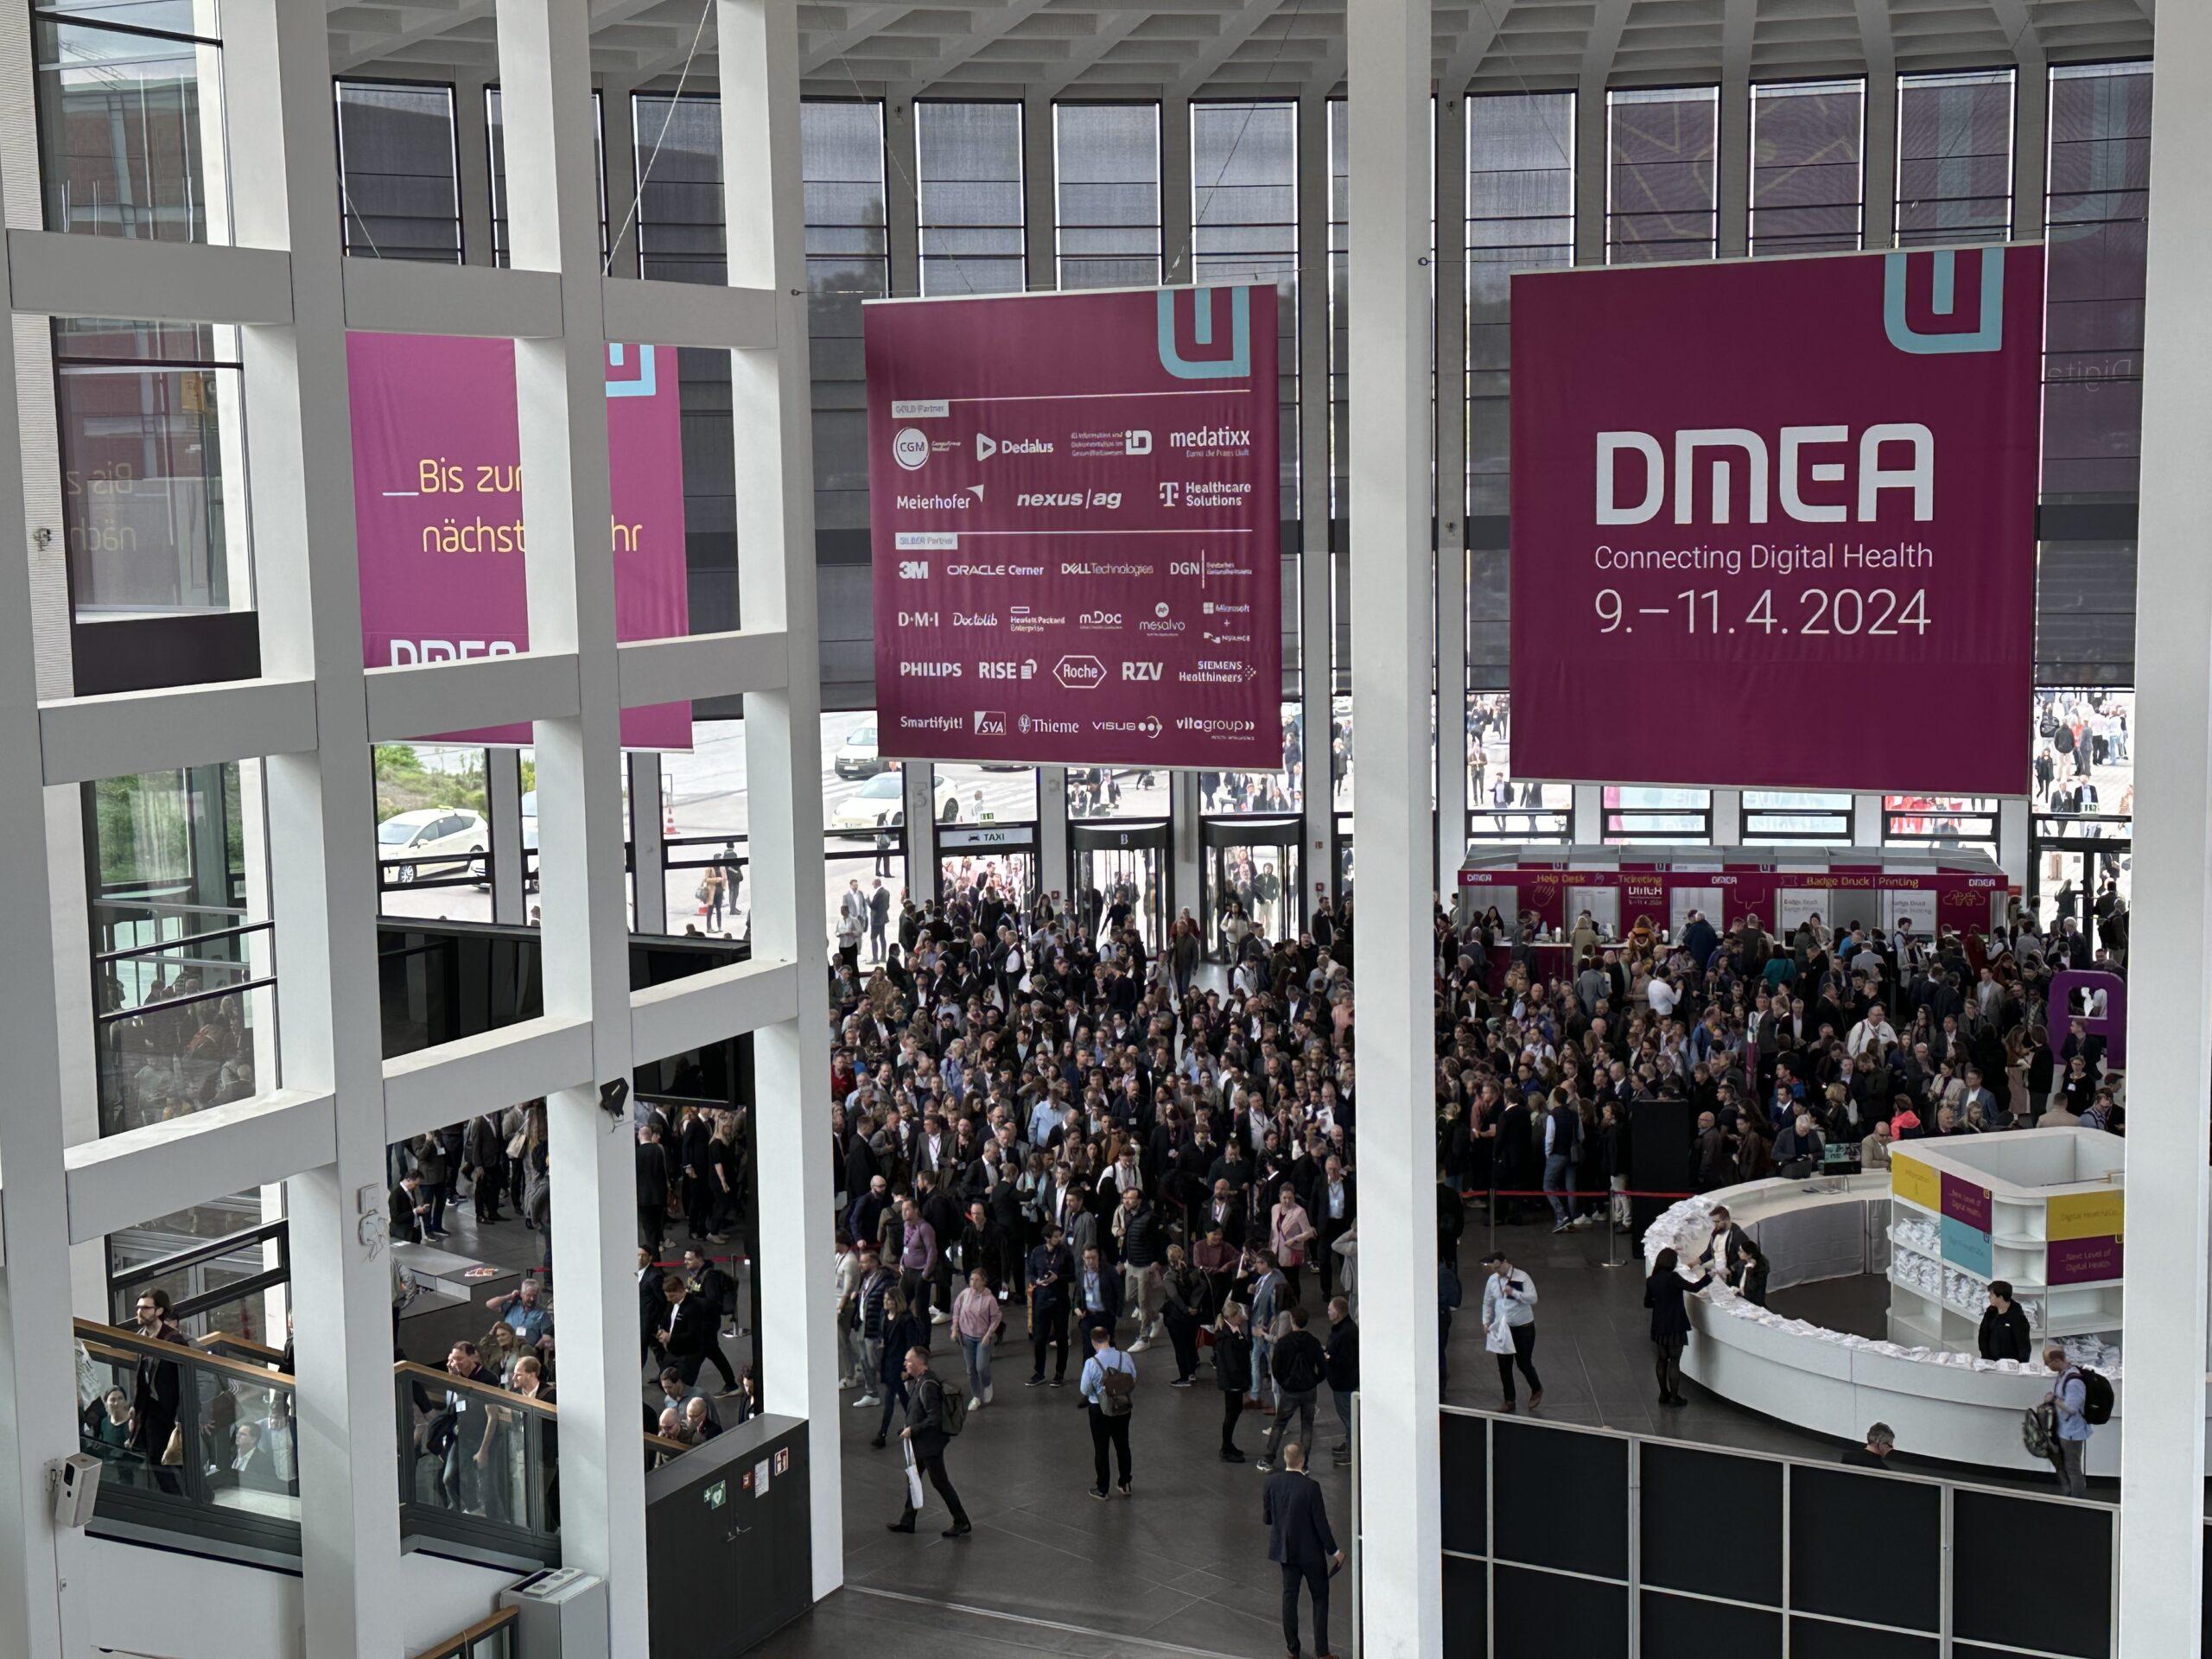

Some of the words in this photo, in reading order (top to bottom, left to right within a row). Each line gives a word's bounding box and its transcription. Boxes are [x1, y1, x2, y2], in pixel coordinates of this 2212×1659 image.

[918, 404, 944, 413] Partner
[1170, 425, 1250, 447] medatixx
[899, 442, 925, 453] CGM
[1001, 438, 1054, 454] Dedalus
[1596, 423, 1935, 525] DMEA
[1185, 481, 1251, 493] Healthcare
[897, 493, 971, 510] Meierhofer
[1185, 495, 1242, 506] Solutions
[1595, 545, 1741, 575] Connecting
[1751, 543, 1833, 575] Digital
[1844, 542, 1933, 568] Health
[899, 561, 929, 579] 3M
[947, 565, 1006, 575] ORACLE
[1008, 564, 1044, 575] Cerner
[1170, 562, 1199, 575] DGN
[952, 612, 998, 626] Doctolib
[1080, 610, 1122, 624] m.Doc
[1139, 619, 1185, 631] mesalvo
[900, 661, 963, 677] PHILIPS
[978, 662, 1017, 679] RISE
[1063, 664, 1098, 678] Roche
[1122, 662, 1163, 681] RZV
[1198, 661, 1243, 671] SIEMENS
[1179, 671, 1243, 683] Healthineers
[982, 721, 1004, 734] SVA
[1032, 718, 1079, 734] Thieme
[1176, 716, 1243, 733] vitagroup
[983, 832, 1005, 842] TAXI
[1537, 874, 1559, 884] Help
[1562, 874, 1586, 882] Desk
[1807, 876, 1839, 887] Badge
[1841, 876, 1871, 886] Druck
[1878, 877, 1919, 888] Printing
